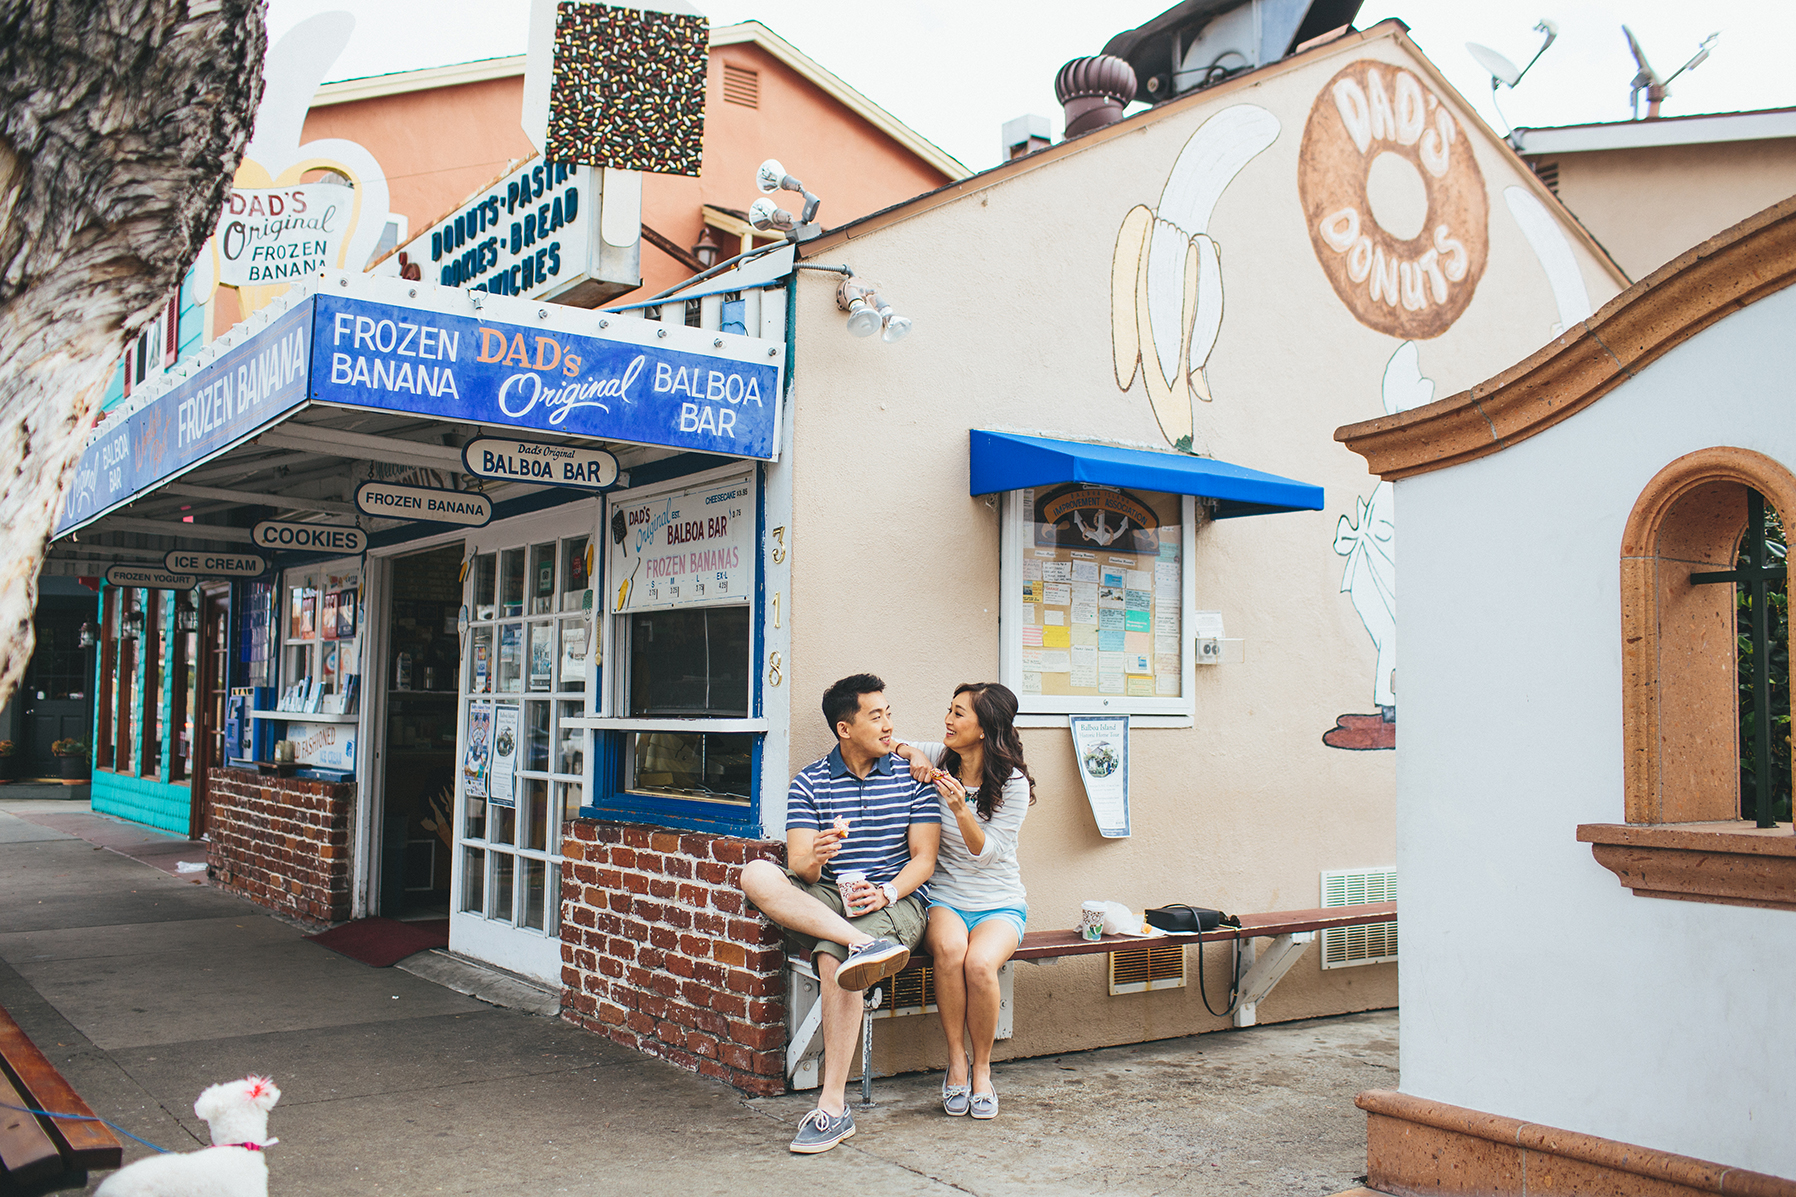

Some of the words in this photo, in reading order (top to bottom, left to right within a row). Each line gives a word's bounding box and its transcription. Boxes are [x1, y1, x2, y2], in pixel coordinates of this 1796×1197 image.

[1332, 68, 1456, 178] DAD'S
[229, 191, 308, 217] DAD'S
[223, 205, 337, 261] Original
[431, 195, 499, 262] DONUTS
[510, 187, 579, 255] BREAD
[252, 240, 328, 261] FROZEN
[1319, 207, 1468, 312] DONUTS
[249, 260, 326, 281] BANANA
[334, 313, 459, 362] FROZEN
[178, 372, 233, 449] FROZEN
[237, 326, 305, 415] BANANA
[331, 353, 460, 400] BANANA
[499, 355, 646, 425] Original
[654, 362, 763, 408] BALBOA
[679, 403, 736, 438] BAR
[102, 433, 129, 470] BALBOA
[482, 450, 554, 479] BALBOA
[562, 460, 601, 483] BAR
[517, 443, 542, 456] Dad's
[543, 446, 576, 461] Original
[109, 466, 122, 493] BAR
[365, 492, 423, 509] FROZEN
[427, 499, 485, 516] BANANA
[705, 490, 736, 505] CHEESECAKE
[1053, 497, 1100, 517] IMPROVEMENT
[1104, 498, 1148, 526] ASSOCIATION
[628, 506, 650, 526] DAD'S
[635, 497, 671, 553] Original
[667, 520, 704, 545] BALBOA
[708, 515, 728, 538] BAR
[262, 526, 359, 549] COOKIES
[113, 571, 151, 582] FROZEN
[152, 573, 191, 584] YOGURT
[174, 556, 199, 569] ICE
[205, 557, 257, 571] CREAM
[646, 555, 686, 579] FROZEN
[690, 546, 739, 573] BANANAS
[650, 580, 656, 588] S
[696, 574, 700, 583] L
[302, 726, 336, 759] FASHIONED
[1080, 723, 1099, 731] Balboa
[1099, 723, 1117, 731] Island
